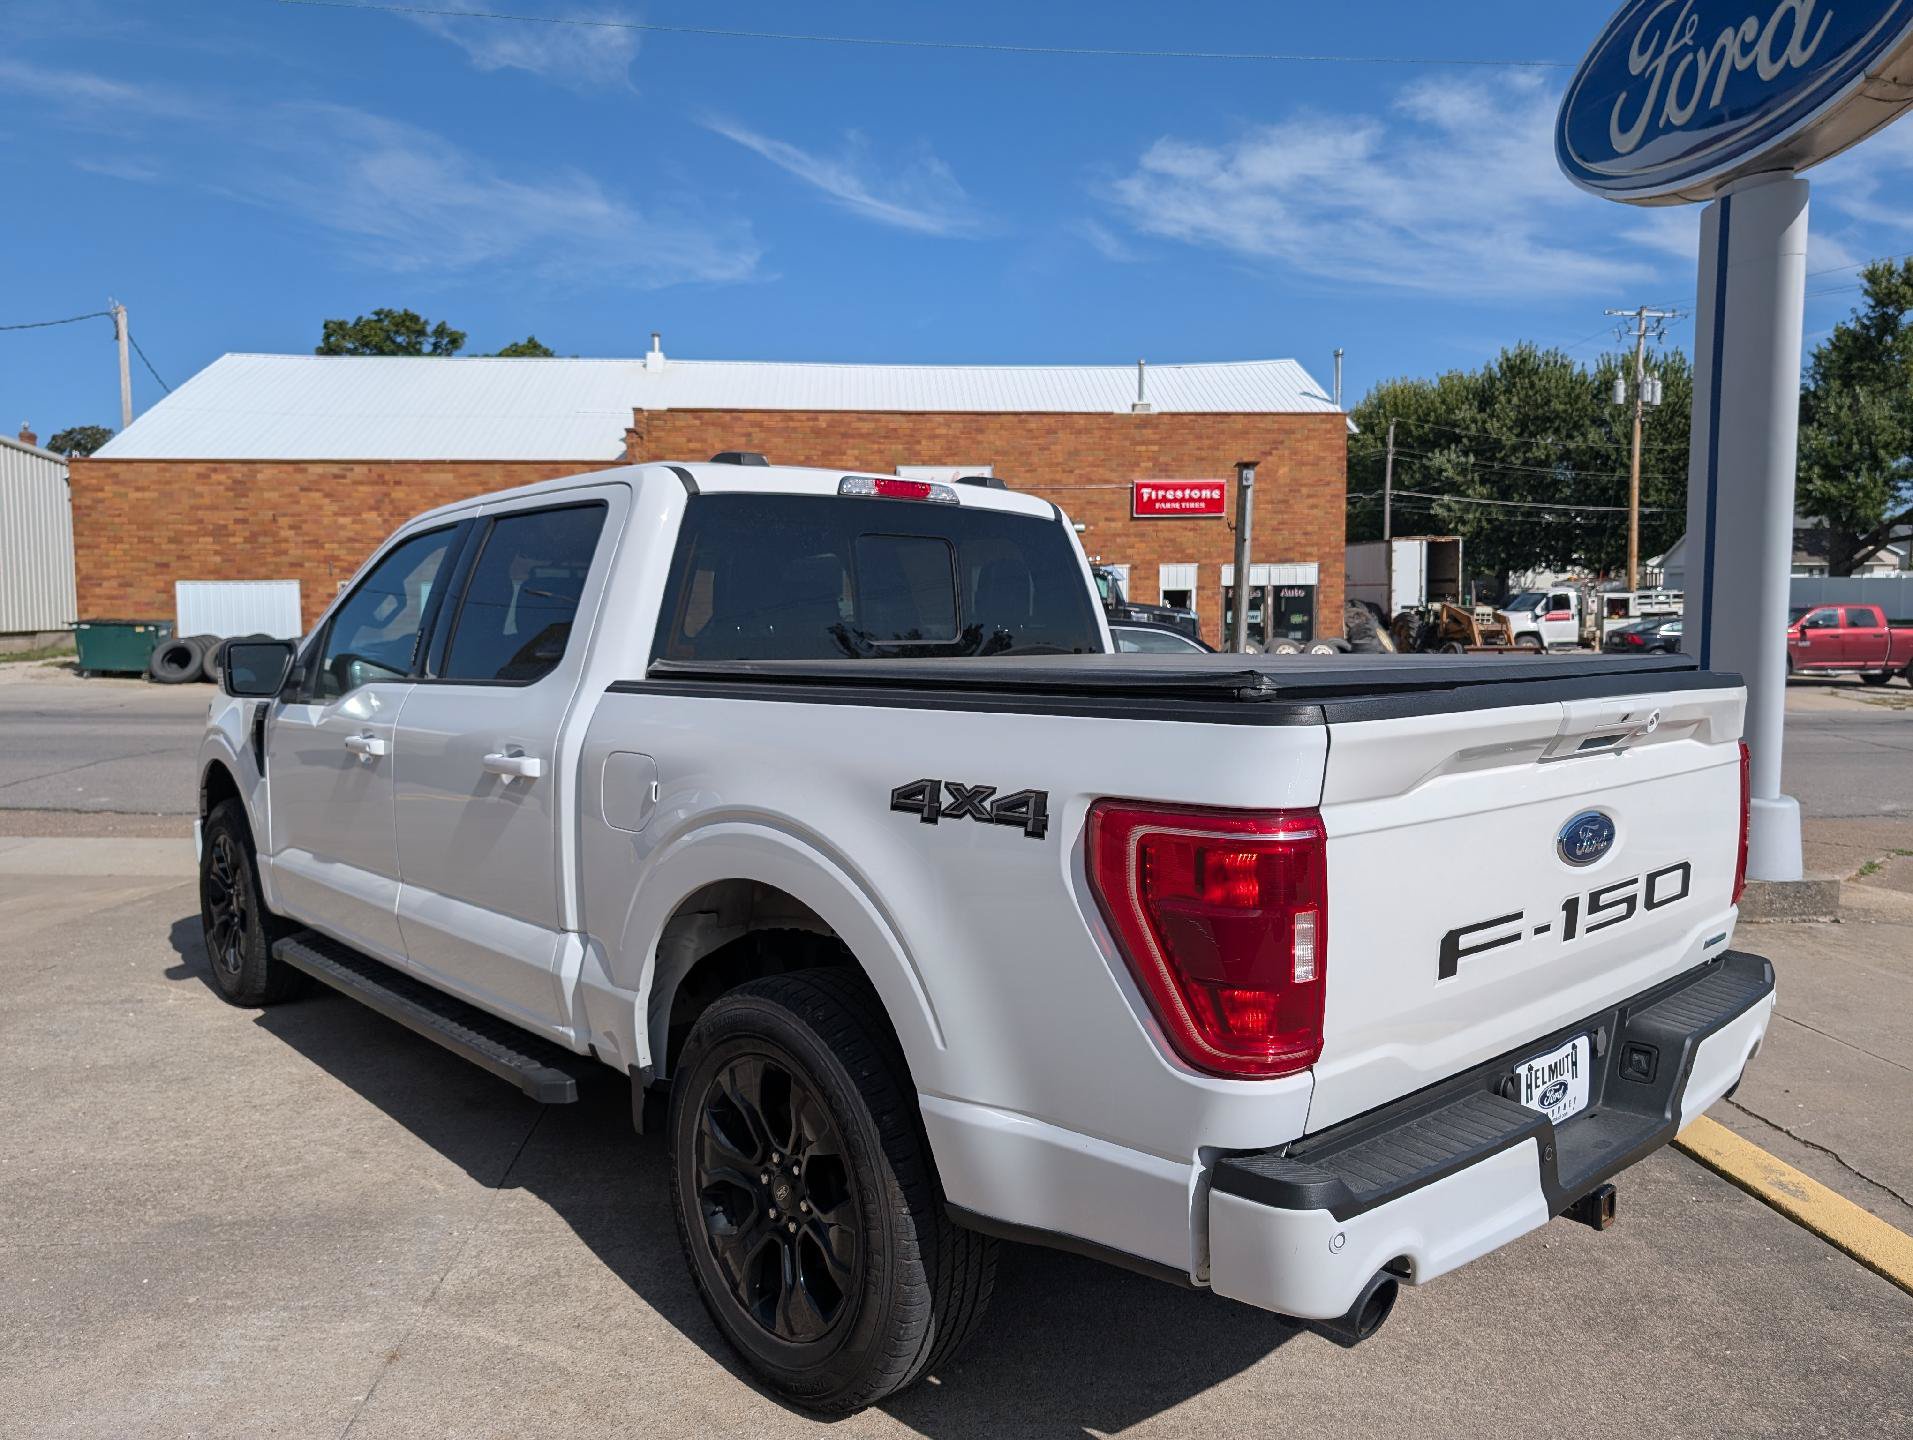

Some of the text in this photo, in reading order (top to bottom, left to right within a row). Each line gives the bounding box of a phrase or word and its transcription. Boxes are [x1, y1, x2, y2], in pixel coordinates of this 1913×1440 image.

[1610, 0, 1834, 154] Ford
[1141, 487, 1221, 502] Firestone
[1280, 587, 1306, 598] Auto
[1576, 824, 1608, 855] Ford
[1438, 862, 1691, 980] F-150
[1526, 1044, 1578, 1104] HELMUTH
[1544, 1084, 1566, 1105] Ford
